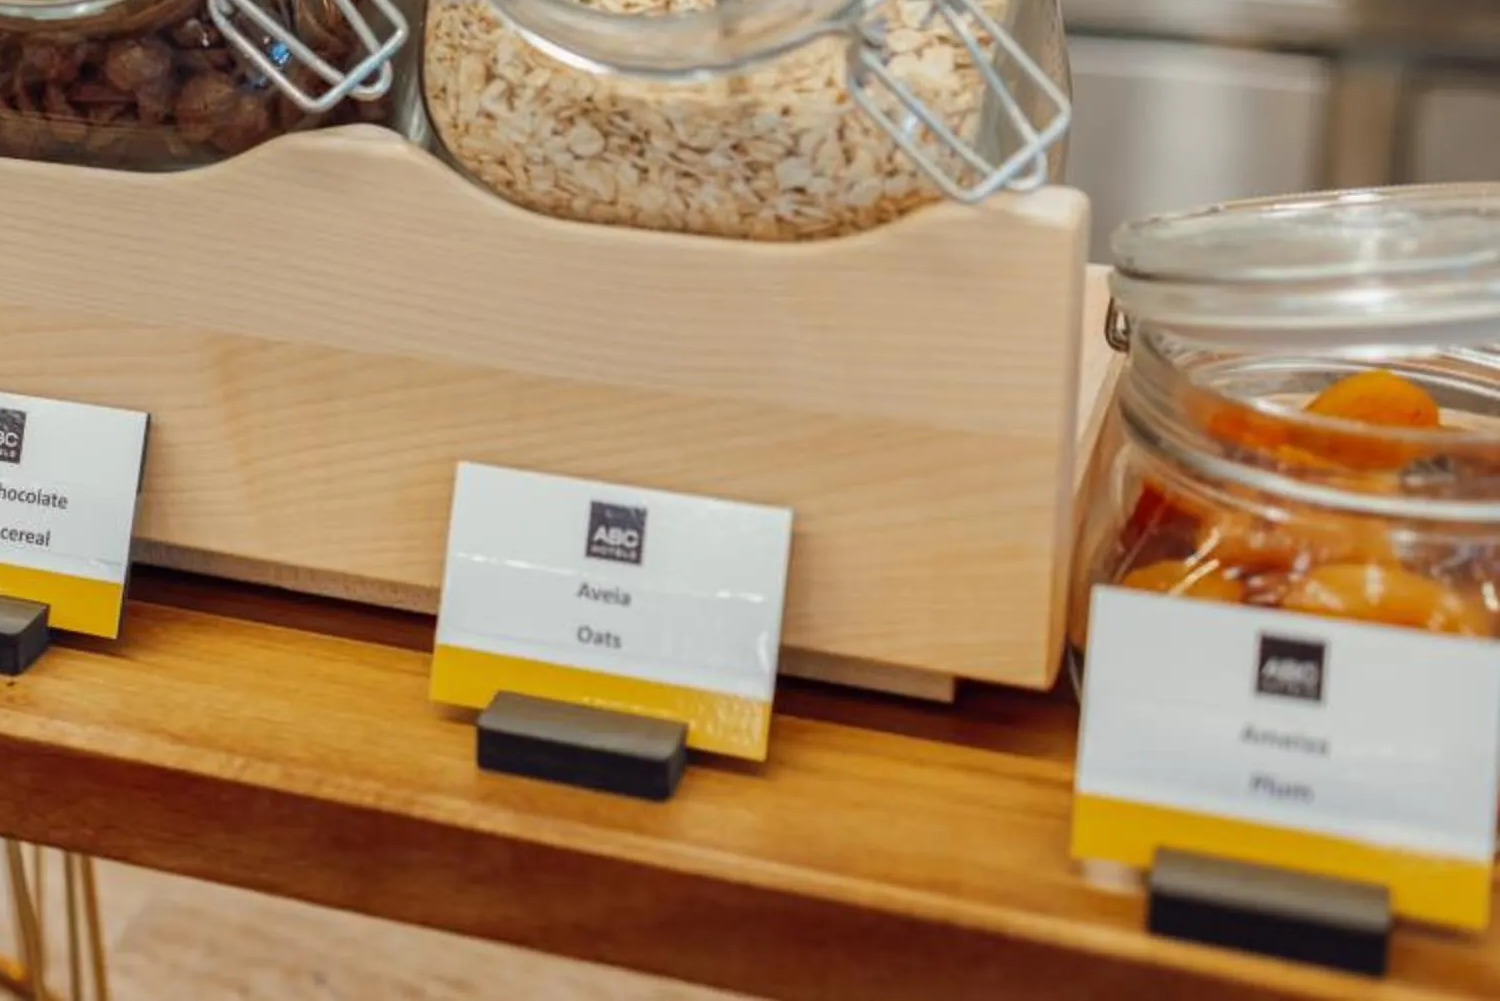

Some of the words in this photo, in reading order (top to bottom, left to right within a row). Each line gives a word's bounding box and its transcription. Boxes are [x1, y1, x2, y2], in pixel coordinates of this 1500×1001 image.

[0, 526, 51, 546] cereal
[593, 525, 639, 548] ABC
[577, 625, 622, 649] Oats
